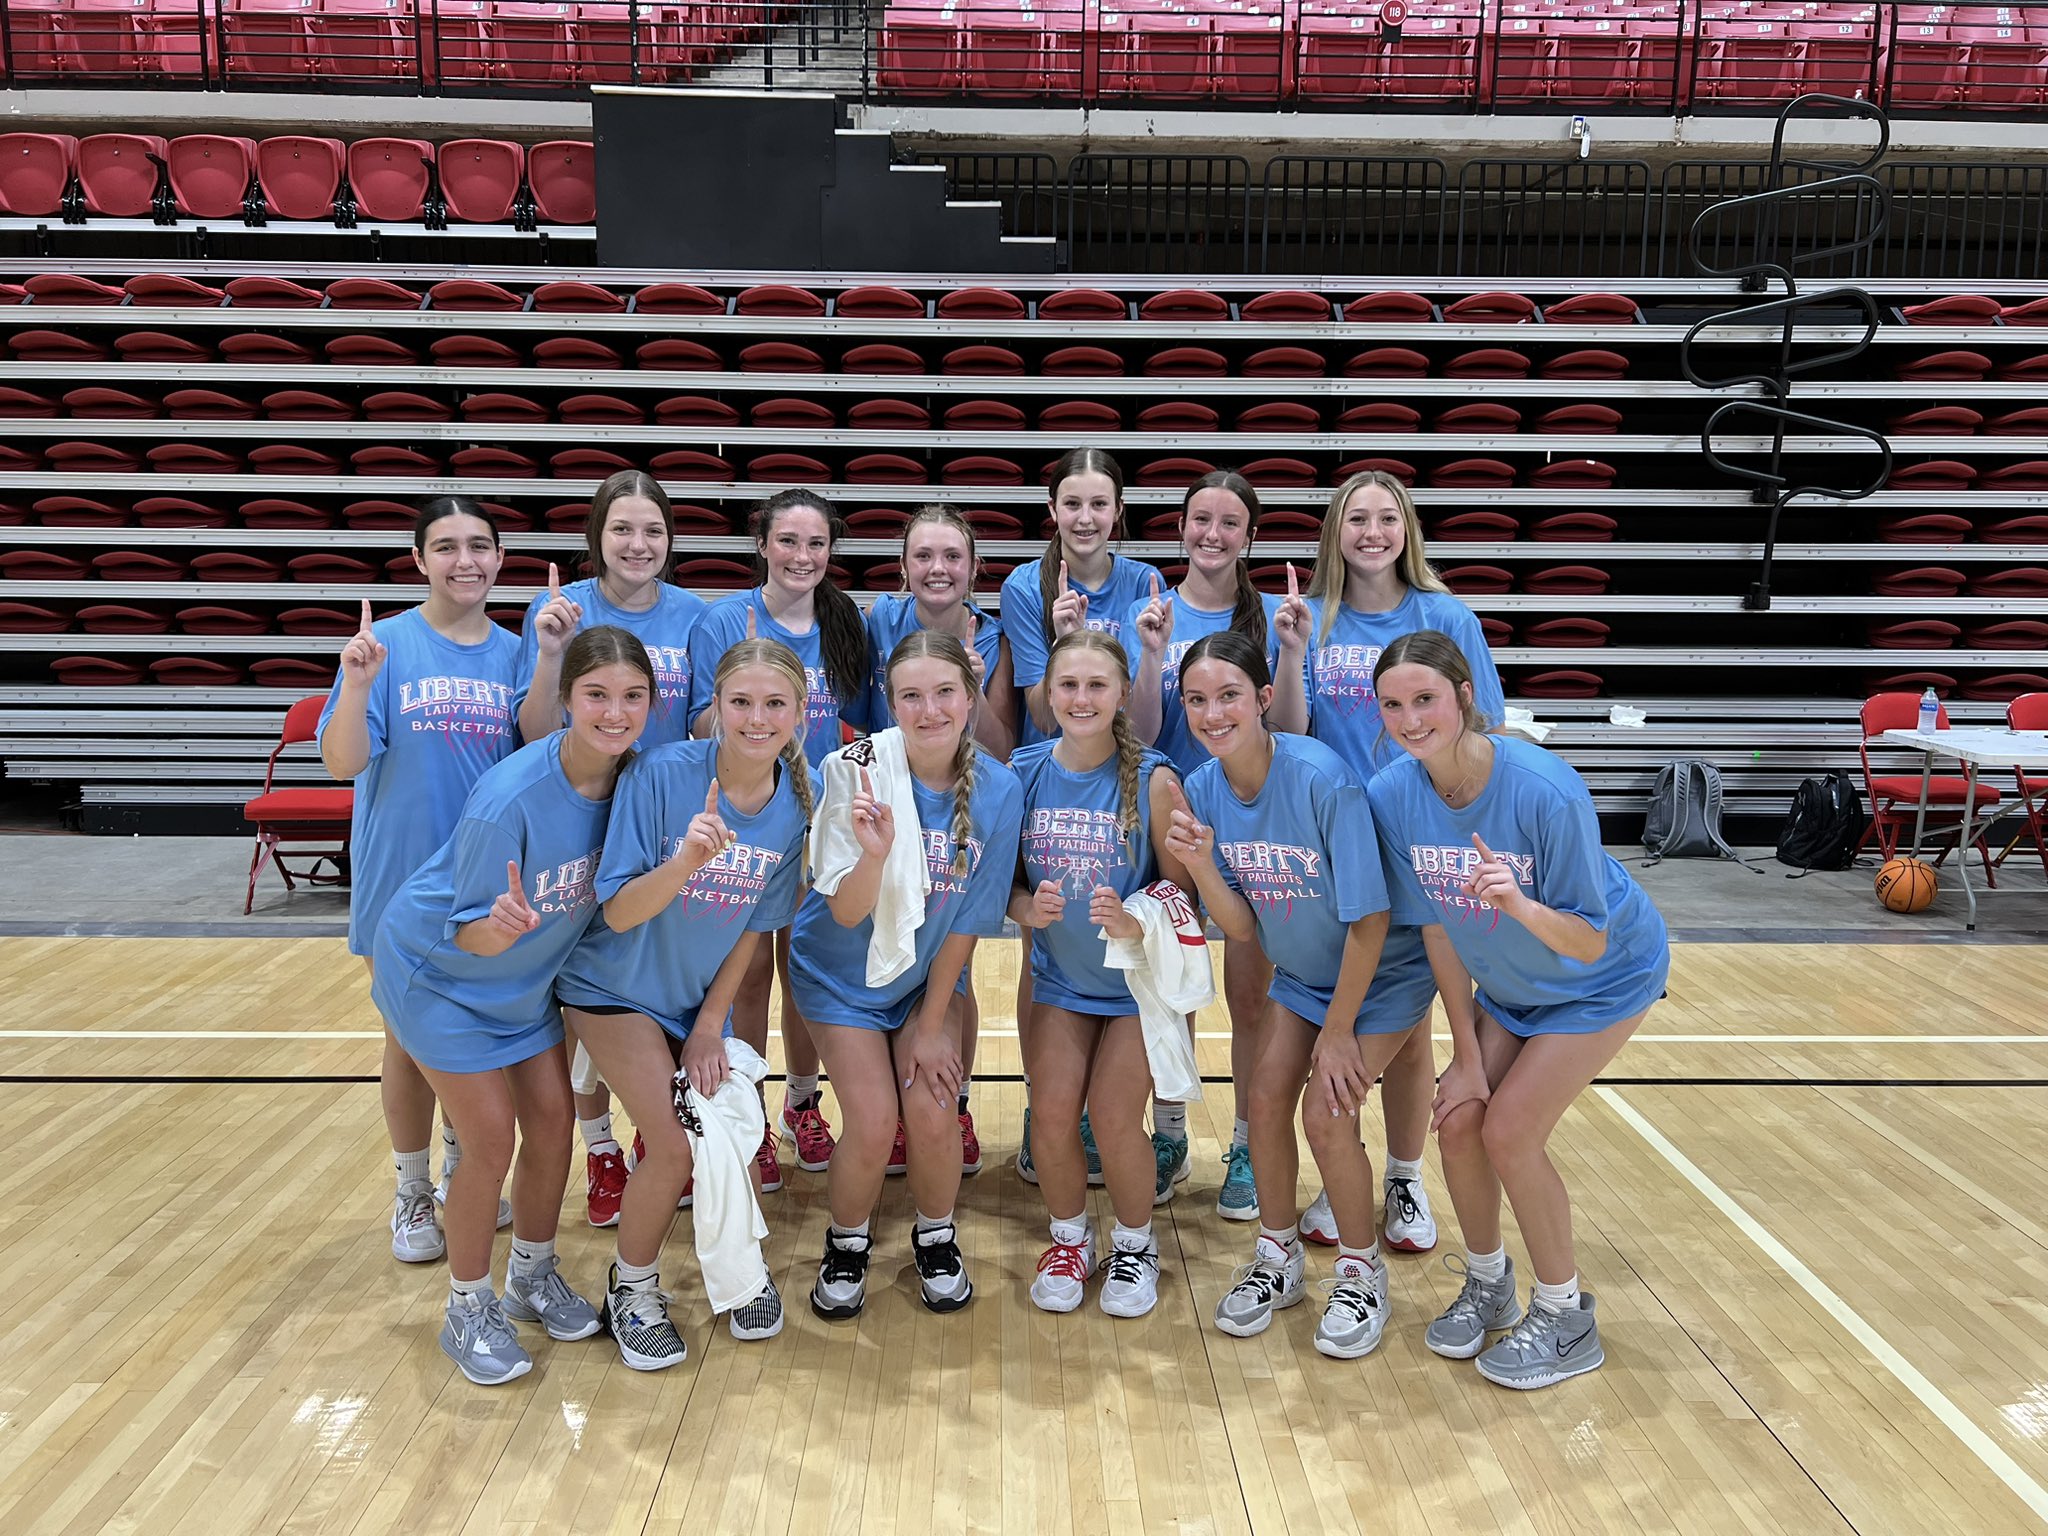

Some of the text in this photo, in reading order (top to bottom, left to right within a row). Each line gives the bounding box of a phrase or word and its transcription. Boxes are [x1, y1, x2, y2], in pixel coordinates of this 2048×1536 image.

[1389, 7, 1401, 17] 118
[1312, 644, 1383, 673] IBER
[1318, 670, 1348, 682] LADY
[1317, 686, 1371, 697] ASKET
[425, 704, 460, 716] LADY
[411, 720, 512, 737] BASKETBAL
[1021, 807, 1127, 845] BERTY
[1031, 838, 1115, 853] ADY PATRIOTS
[1219, 840, 1321, 877] BERTY
[1410, 845, 1535, 885] IBERY
[689, 871, 767, 891] DY PATRIOTS
[1248, 872, 1303, 885] PATRIOTS
[1420, 875, 1449, 887] LADY
[678, 885, 758, 905] SKETBAL
[1245, 888, 1321, 900] KETBALL
[1424, 889, 1497, 909] SKETB
